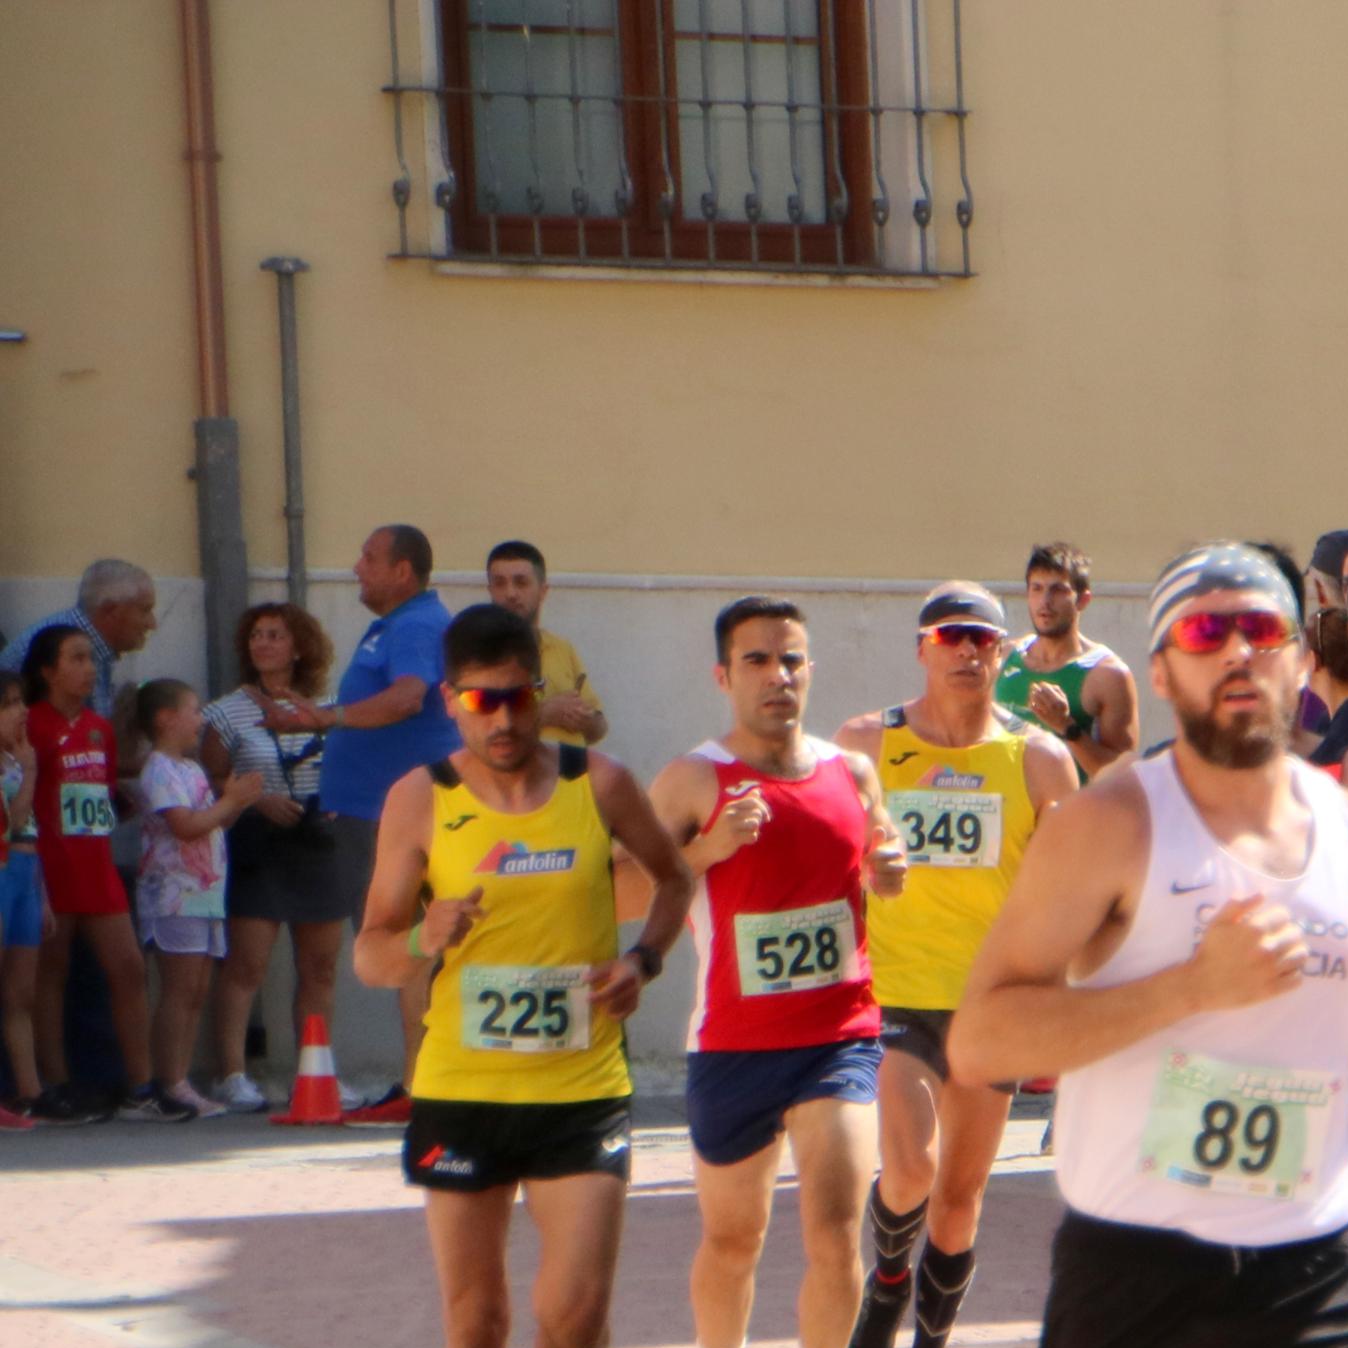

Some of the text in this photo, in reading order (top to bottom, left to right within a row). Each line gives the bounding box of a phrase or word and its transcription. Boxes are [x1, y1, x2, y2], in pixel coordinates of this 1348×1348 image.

[902, 811, 982, 854] 349
[504, 853, 568, 874] antolin
[756, 926, 840, 980] 528
[478, 990, 569, 1038] 225
[1193, 1100, 1281, 1176] 89
